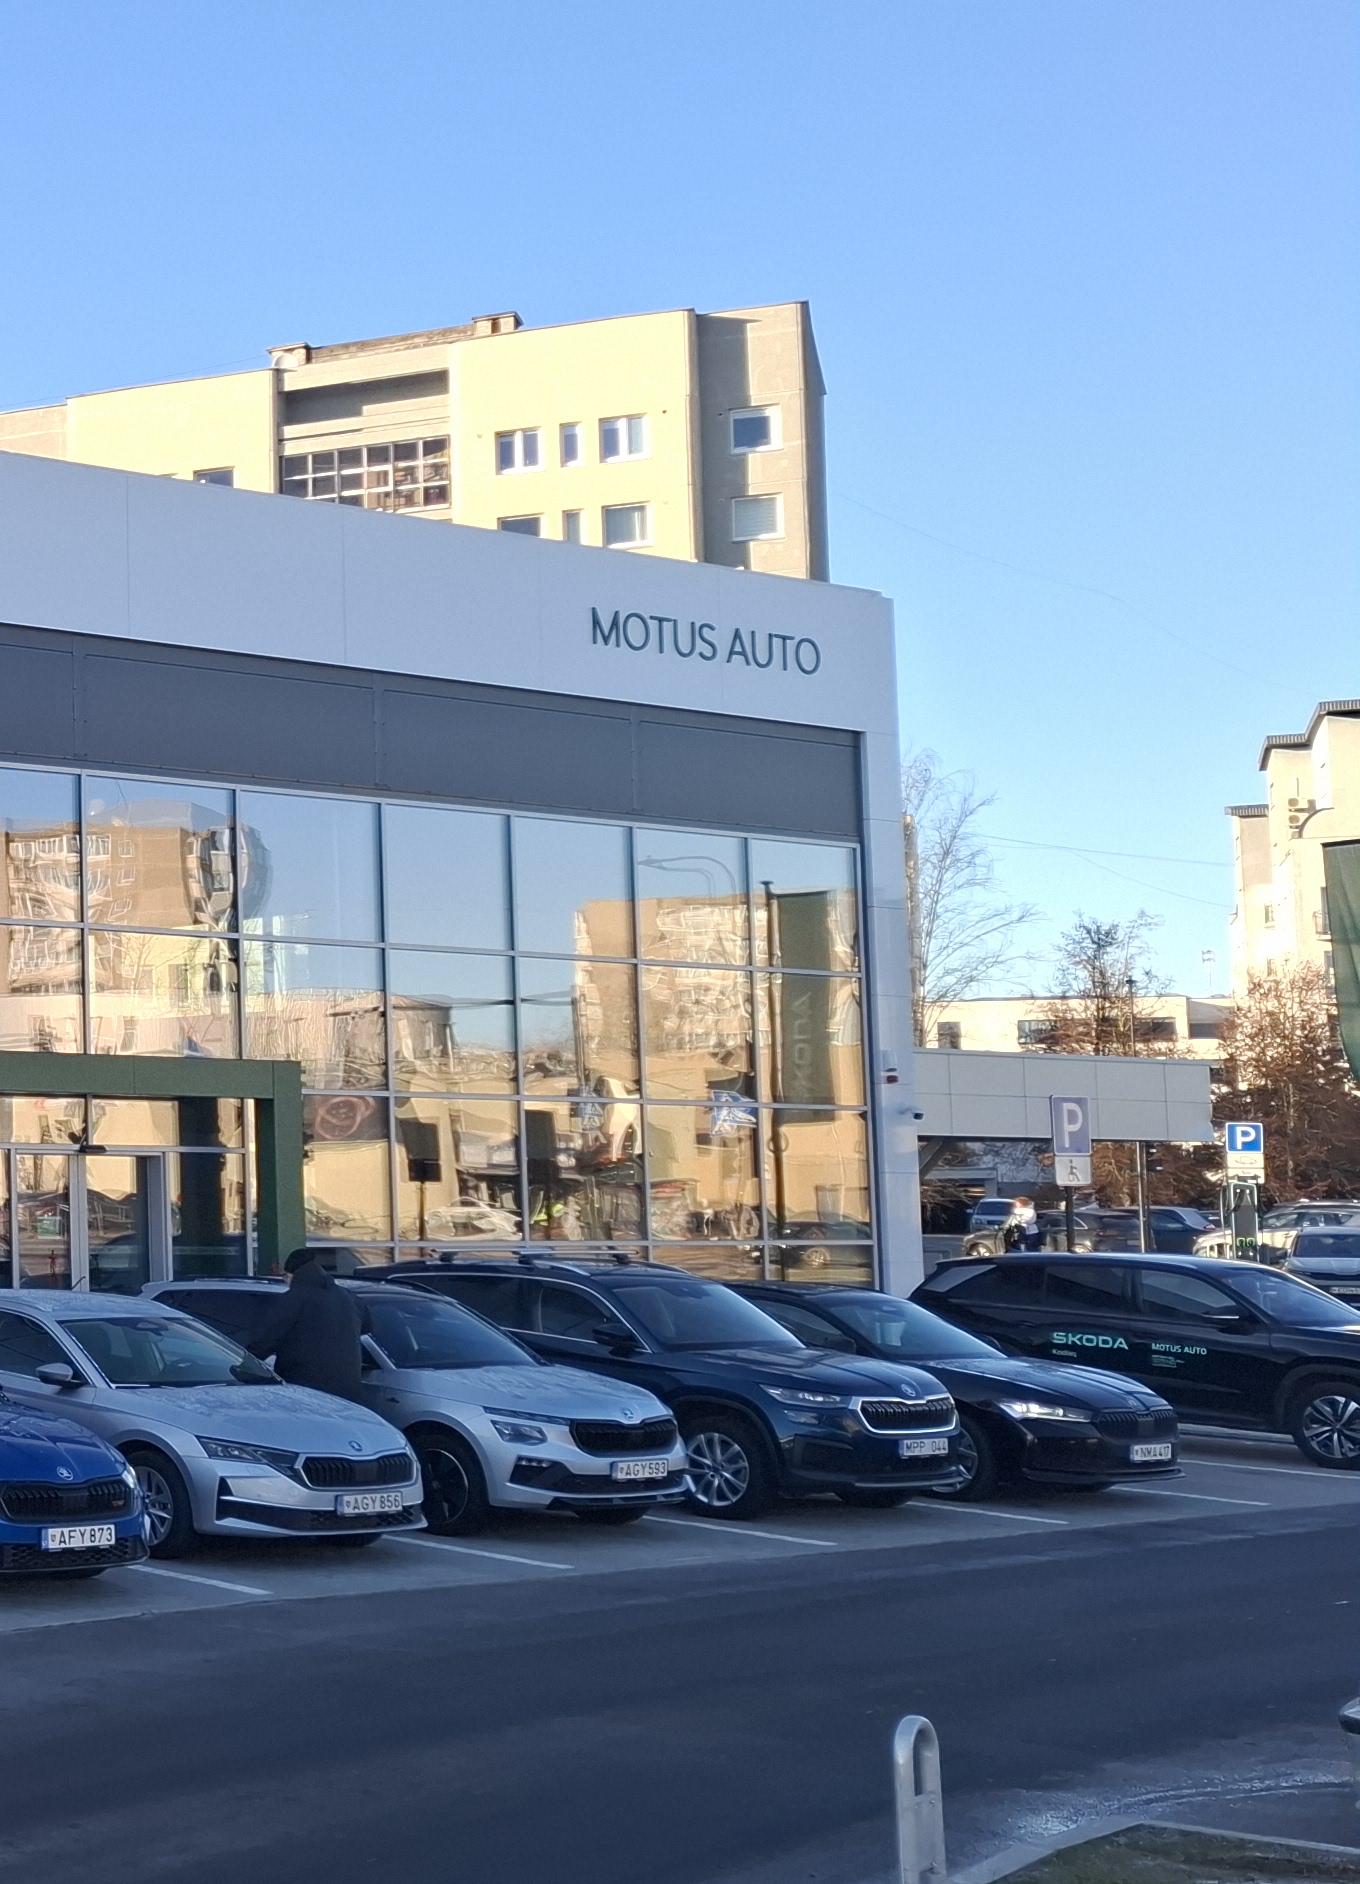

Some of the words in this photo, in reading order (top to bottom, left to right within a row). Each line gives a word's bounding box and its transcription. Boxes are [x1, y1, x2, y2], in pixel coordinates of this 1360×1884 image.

[590, 606, 718, 661] MOTUS
[726, 627, 821, 675] AUTO
[1062, 1102, 1083, 1148] P
[1235, 1125, 1256, 1150] P
[1052, 1331, 1129, 1350] SKODA
[1151, 1342, 1182, 1353] MOTUS
[1183, 1345, 1208, 1355] AUTO
